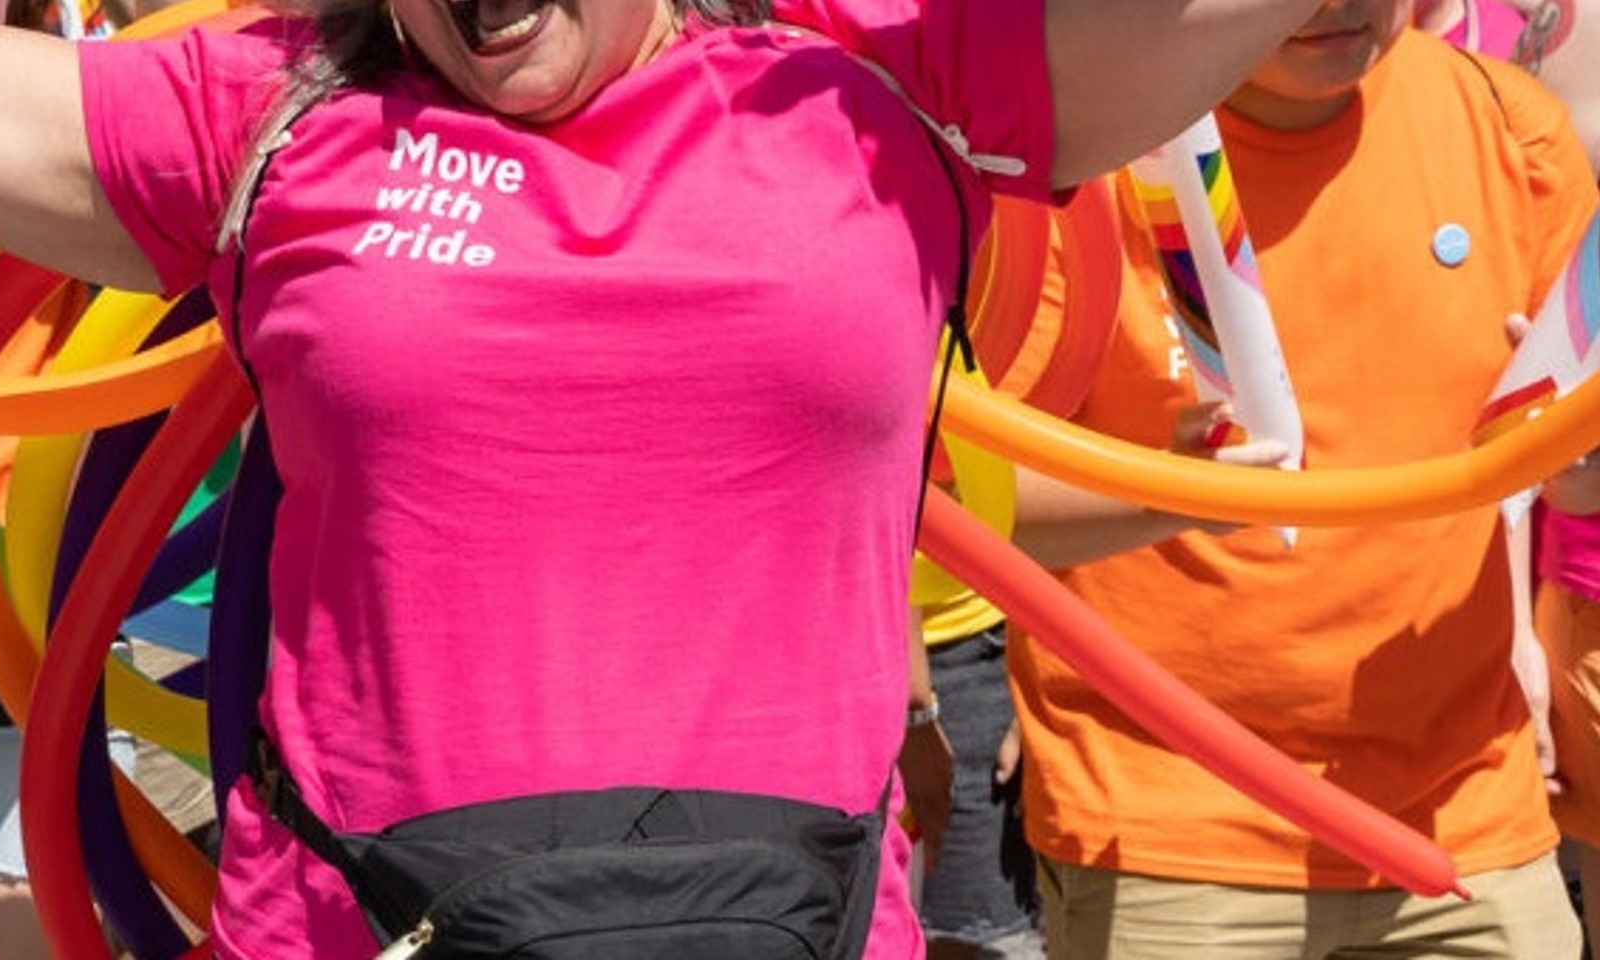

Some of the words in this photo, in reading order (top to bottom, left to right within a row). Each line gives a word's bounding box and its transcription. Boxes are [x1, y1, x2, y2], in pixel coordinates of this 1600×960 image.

[388, 127, 525, 193] Move
[376, 183, 483, 225] with
[352, 221, 496, 267] Pride
